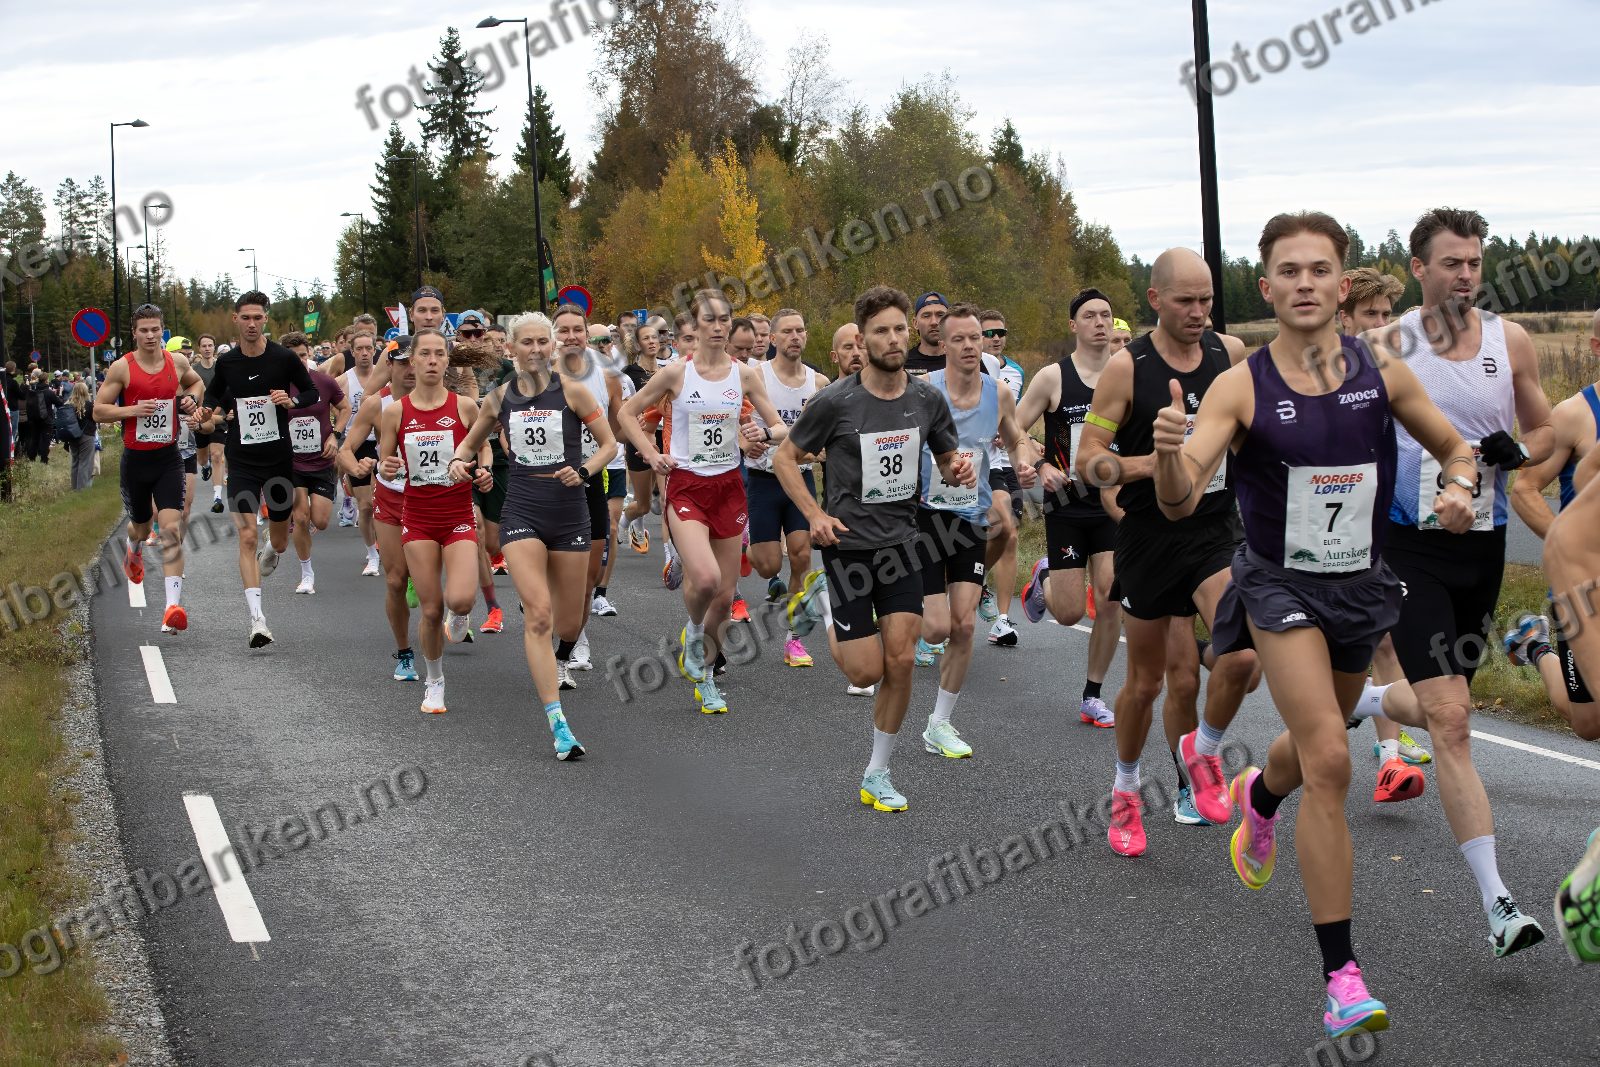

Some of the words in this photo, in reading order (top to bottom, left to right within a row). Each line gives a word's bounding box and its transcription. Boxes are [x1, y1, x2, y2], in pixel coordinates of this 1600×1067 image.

[1338, 388, 1379, 405] zooca
[1351, 402, 1370, 410] SPORT
[144, 415, 167, 428] 392
[249, 412, 265, 426] 20
[295, 429, 315, 440] 794
[524, 427, 547, 446] 33
[703, 428, 723, 447] 36
[875, 434, 910, 445] NORGES
[878, 442, 904, 451] LØPET
[419, 451, 440, 467] 24
[880, 454, 903, 477] 38
[1309, 473, 1364, 485] NORGES
[887, 483, 916, 494] Aurskog
[1314, 484, 1355, 495] LØPET
[1325, 502, 1343, 533] 7
[1324, 546, 1369, 561] Aurskog
[1566, 649, 1577, 684] CRAFT
